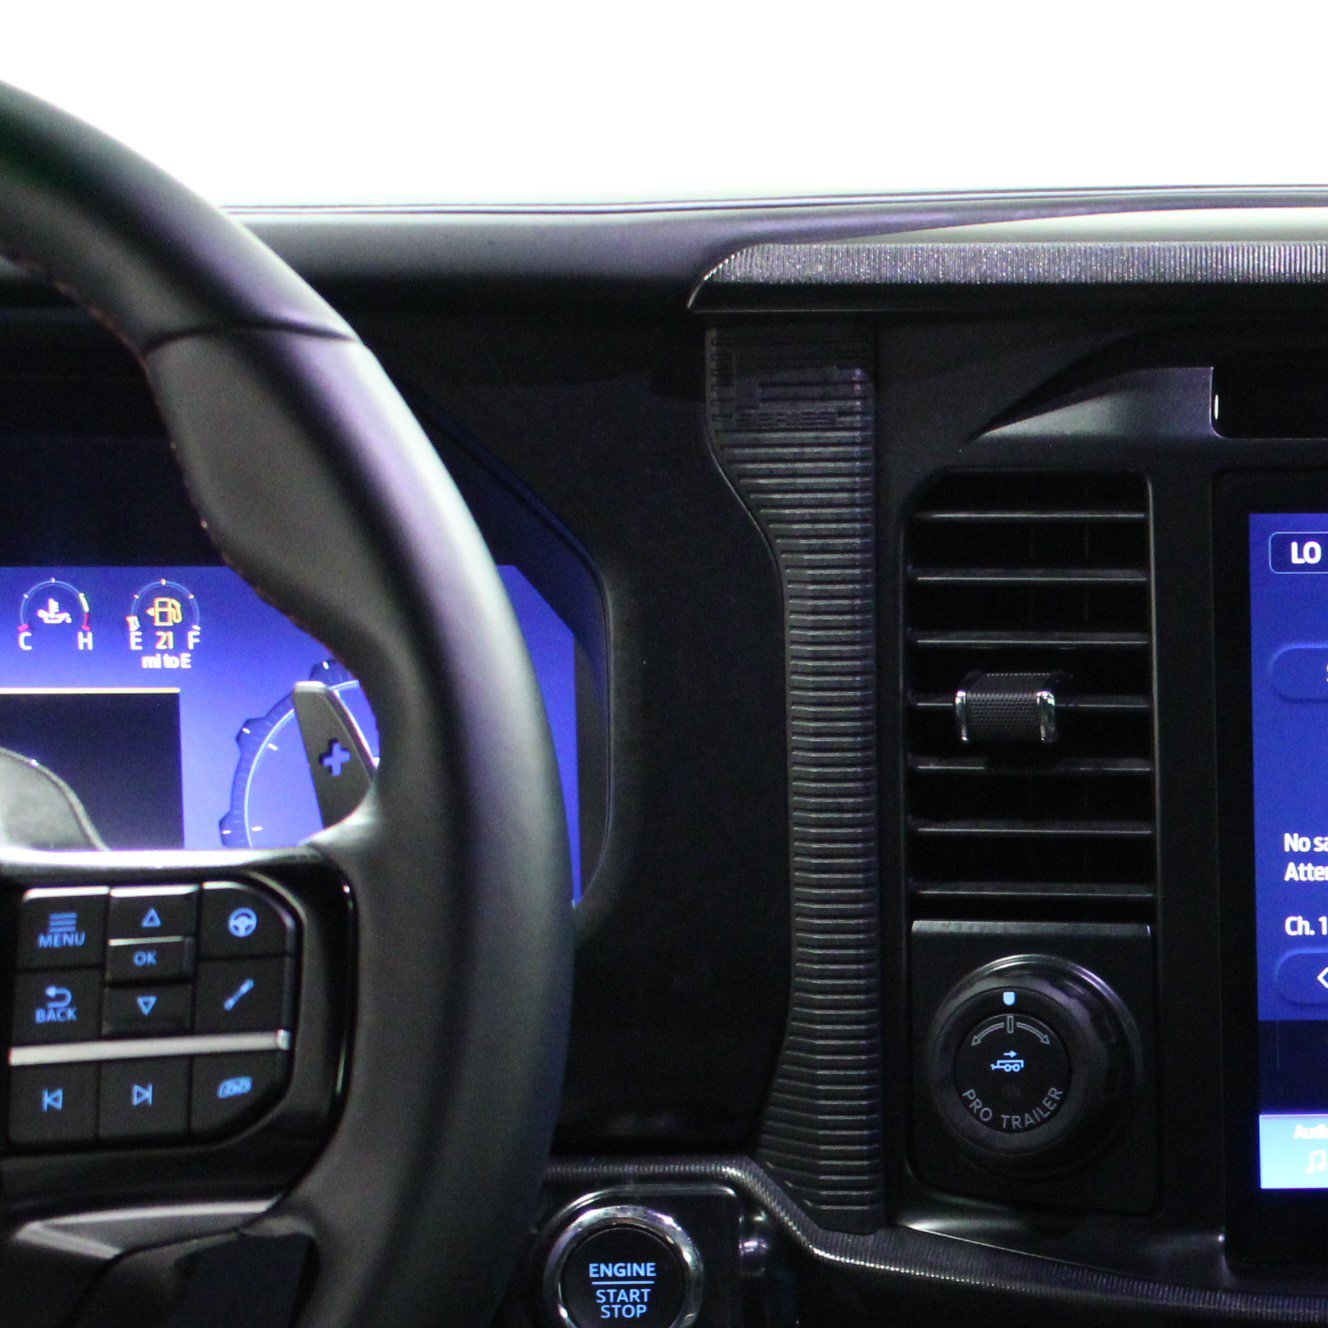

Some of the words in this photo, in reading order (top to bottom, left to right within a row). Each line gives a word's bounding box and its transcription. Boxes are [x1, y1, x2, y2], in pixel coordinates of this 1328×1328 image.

[1290, 542, 1322, 564] LO
[19, 632, 32, 650] C
[78, 631, 93, 650] H
[130, 631, 143, 650] E
[155, 632, 174, 649] 21
[187, 631, 201, 650] F
[141, 654, 161, 669] mi
[163, 654, 179, 669] to
[181, 653, 191, 669] E
[1284, 833, 1310, 852] No
[1285, 916, 1315, 936] Ch.
[1319, 917, 1328, 935] 1
[38, 932, 85, 948] MENU
[133, 952, 157, 966] OK
[35, 1007, 77, 1024] BACK
[962, 1089, 992, 1122] PRO
[1001, 1087, 1064, 1129] TRAILER
[589, 1262, 656, 1277] ENGINE
[596, 1289, 650, 1303] START
[600, 1304, 647, 1319] STOP
